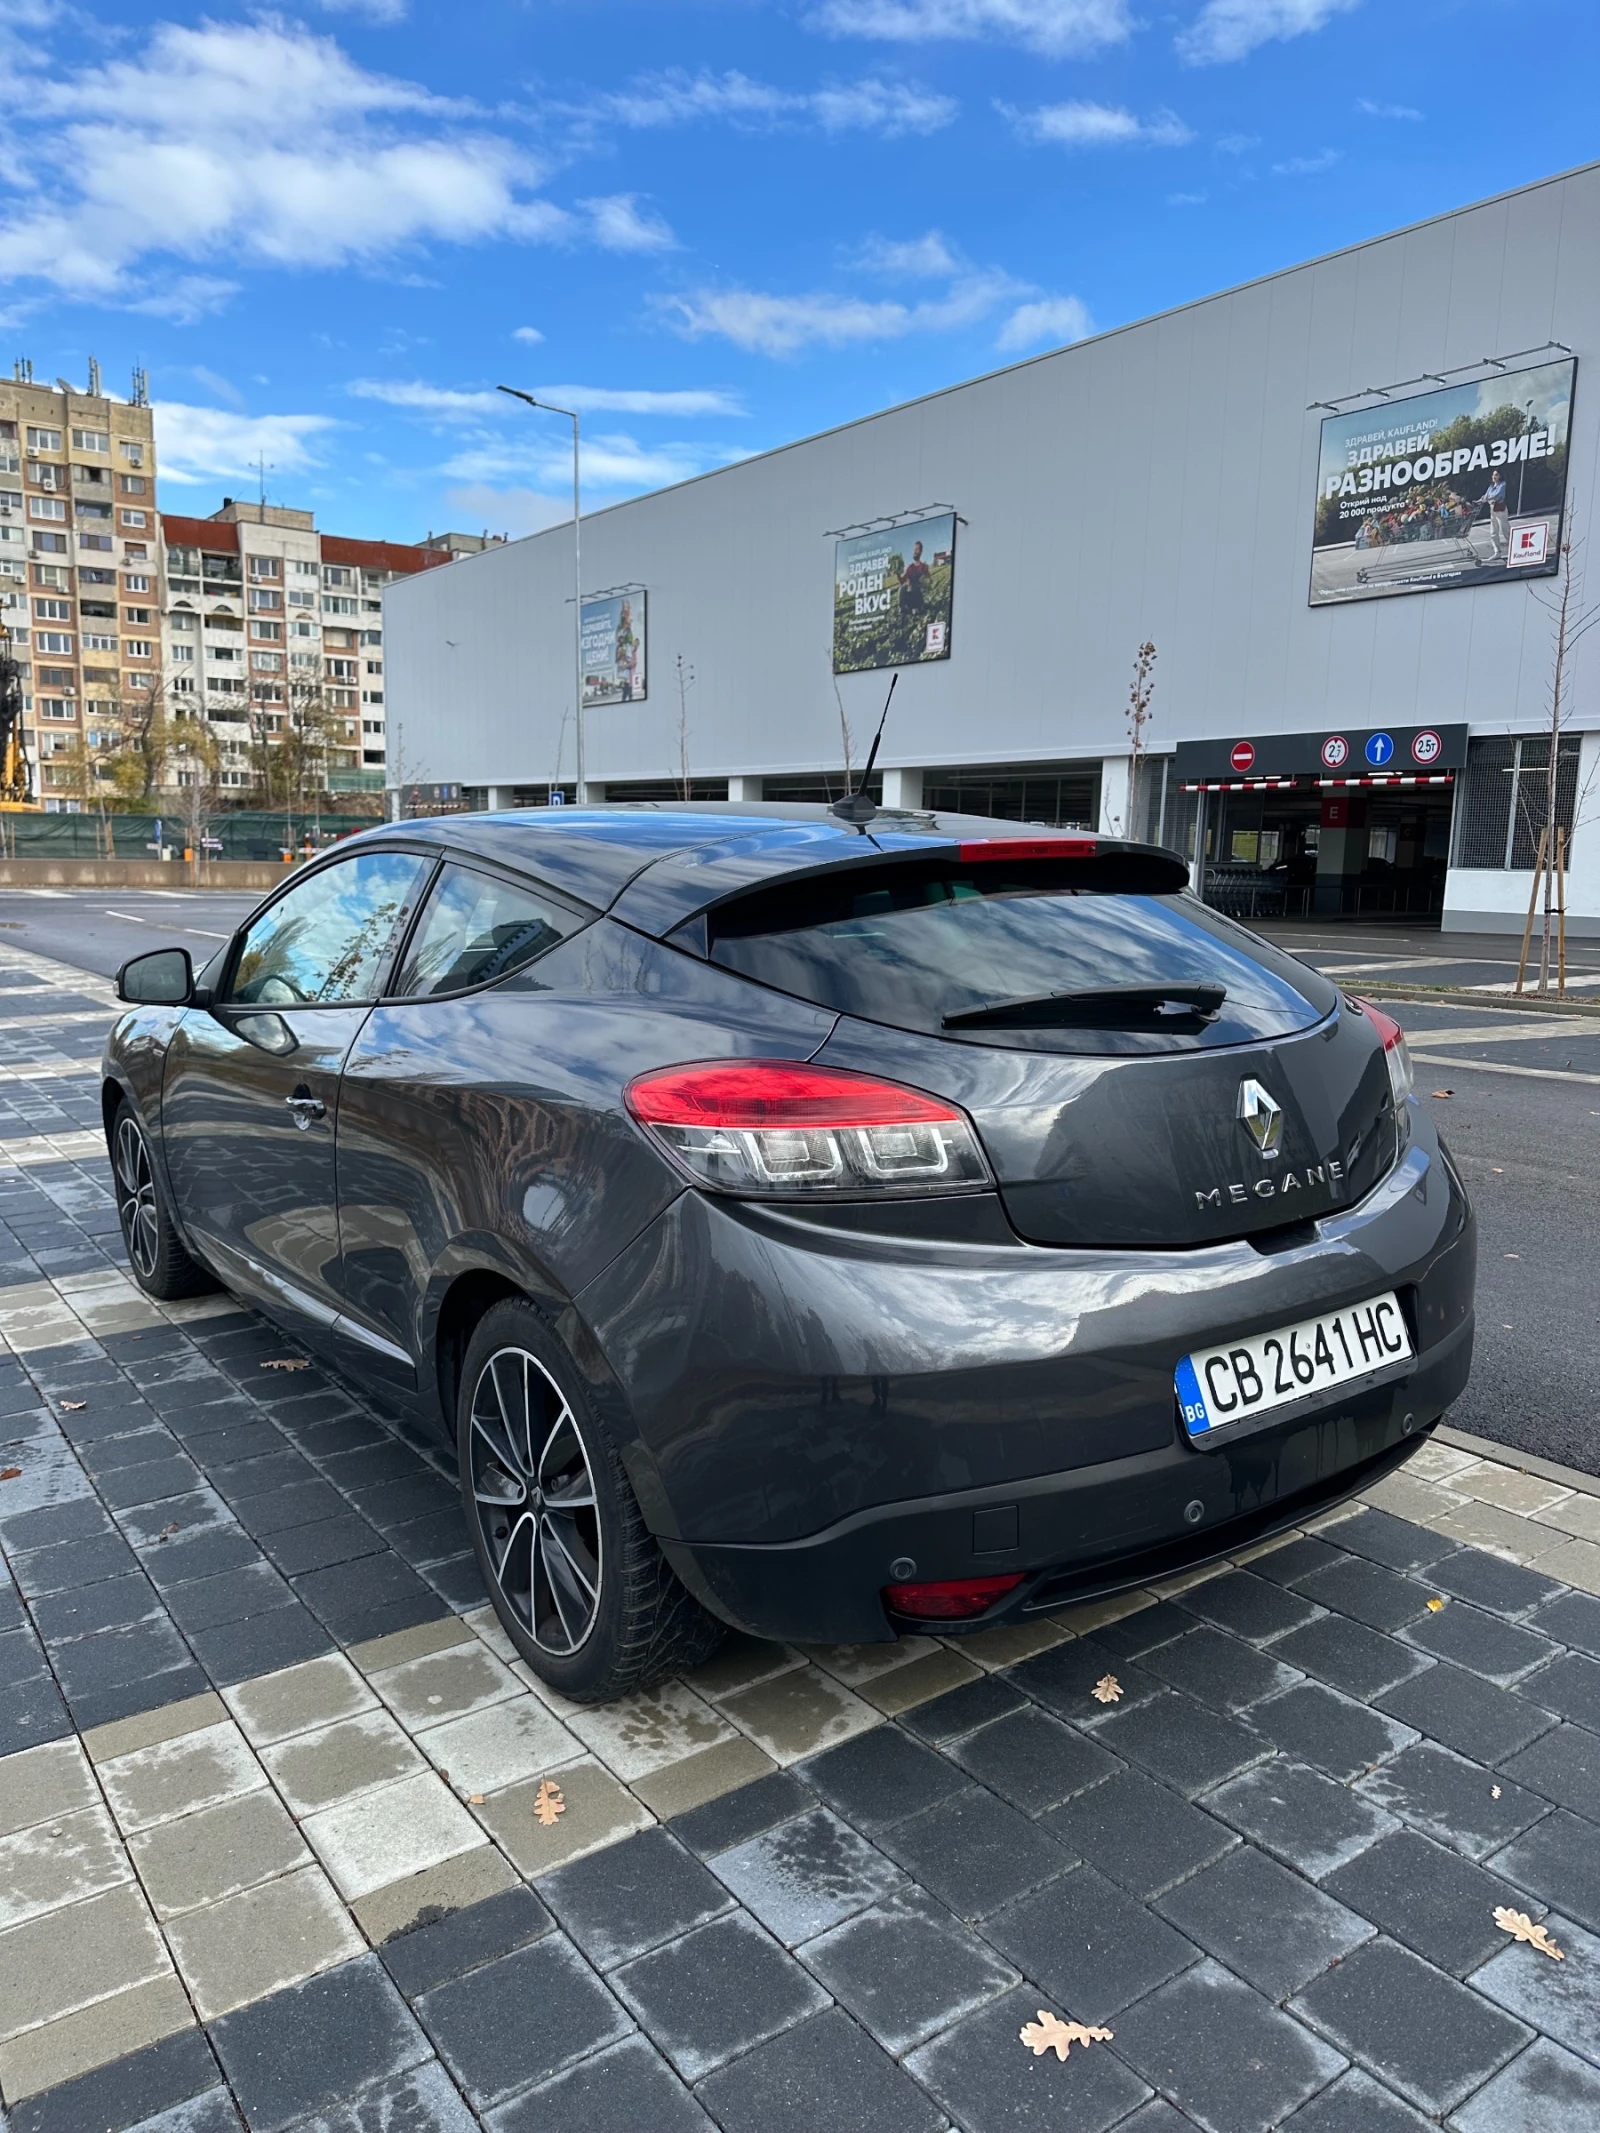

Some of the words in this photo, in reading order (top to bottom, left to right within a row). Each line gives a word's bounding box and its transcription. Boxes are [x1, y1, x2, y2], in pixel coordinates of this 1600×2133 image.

[1345, 430, 1386, 448] ЗДРАВЕЙ,
[1388, 419, 1438, 438] KAUFLAND!
[1325, 424, 1556, 499] РАЗНООБРАЗИЕ!
[1348, 431, 1433, 467] ЗДРАВЕЙ,
[1339, 511, 1349, 519] 20
[1350, 507, 1366, 517] 000
[1340, 497, 1370, 509] Открий
[1371, 495, 1387, 504] над
[849, 554, 891, 576] ЗДРАВЕЙ,
[1513, 549, 1541, 559] Kaufland
[839, 573, 883, 598] РОДЕН
[854, 589, 891, 615] ВКУС!
[1329, 806, 1339, 819] E
[1194, 1160, 1344, 1211] MEGANE
[1204, 1347, 1264, 1413] CB
[1263, 1317, 1354, 1395] 2641
[1352, 1302, 1402, 1363] HC
[1184, 1402, 1205, 1424] BG
